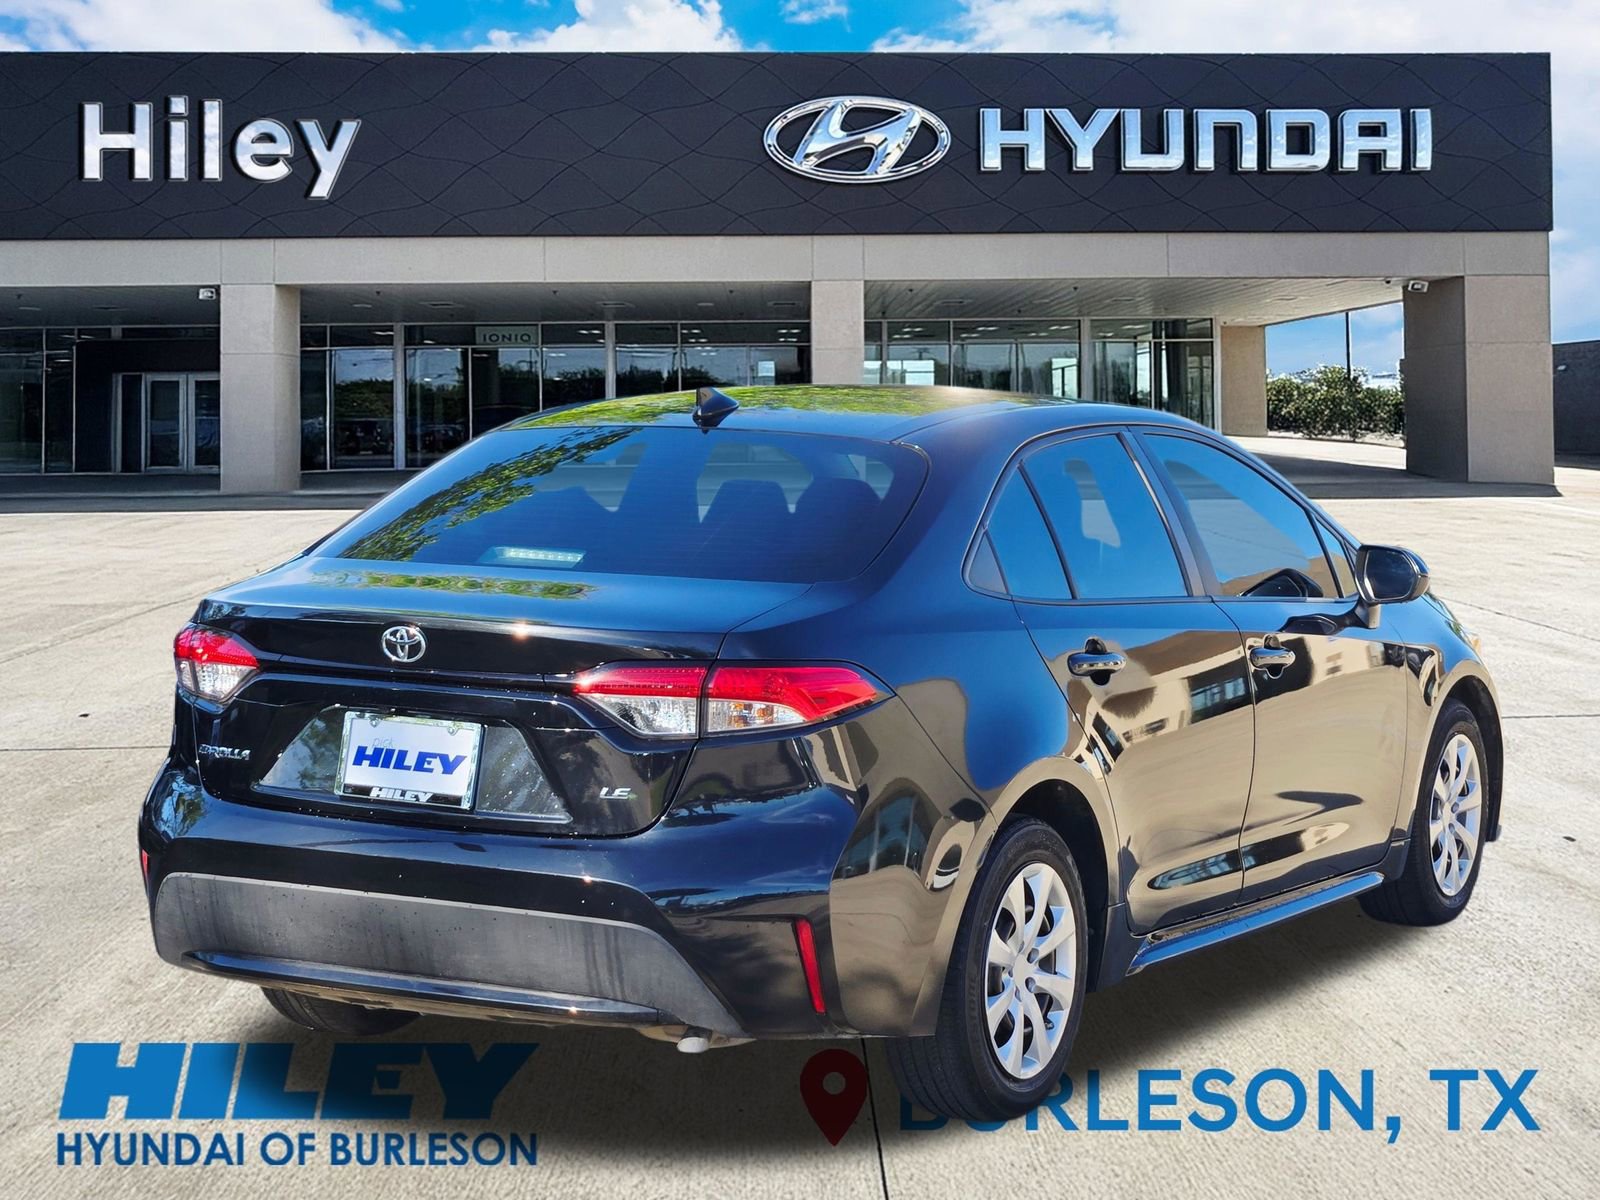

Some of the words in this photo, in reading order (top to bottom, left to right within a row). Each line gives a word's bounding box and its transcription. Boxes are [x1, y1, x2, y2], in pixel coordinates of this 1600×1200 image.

[79, 95, 362, 200] Hiley
[979, 106, 1433, 172] HYUNDAI
[352, 745, 467, 774] HILEY
[370, 786, 433, 802] HILEY
[600, 786, 631, 800] LE
